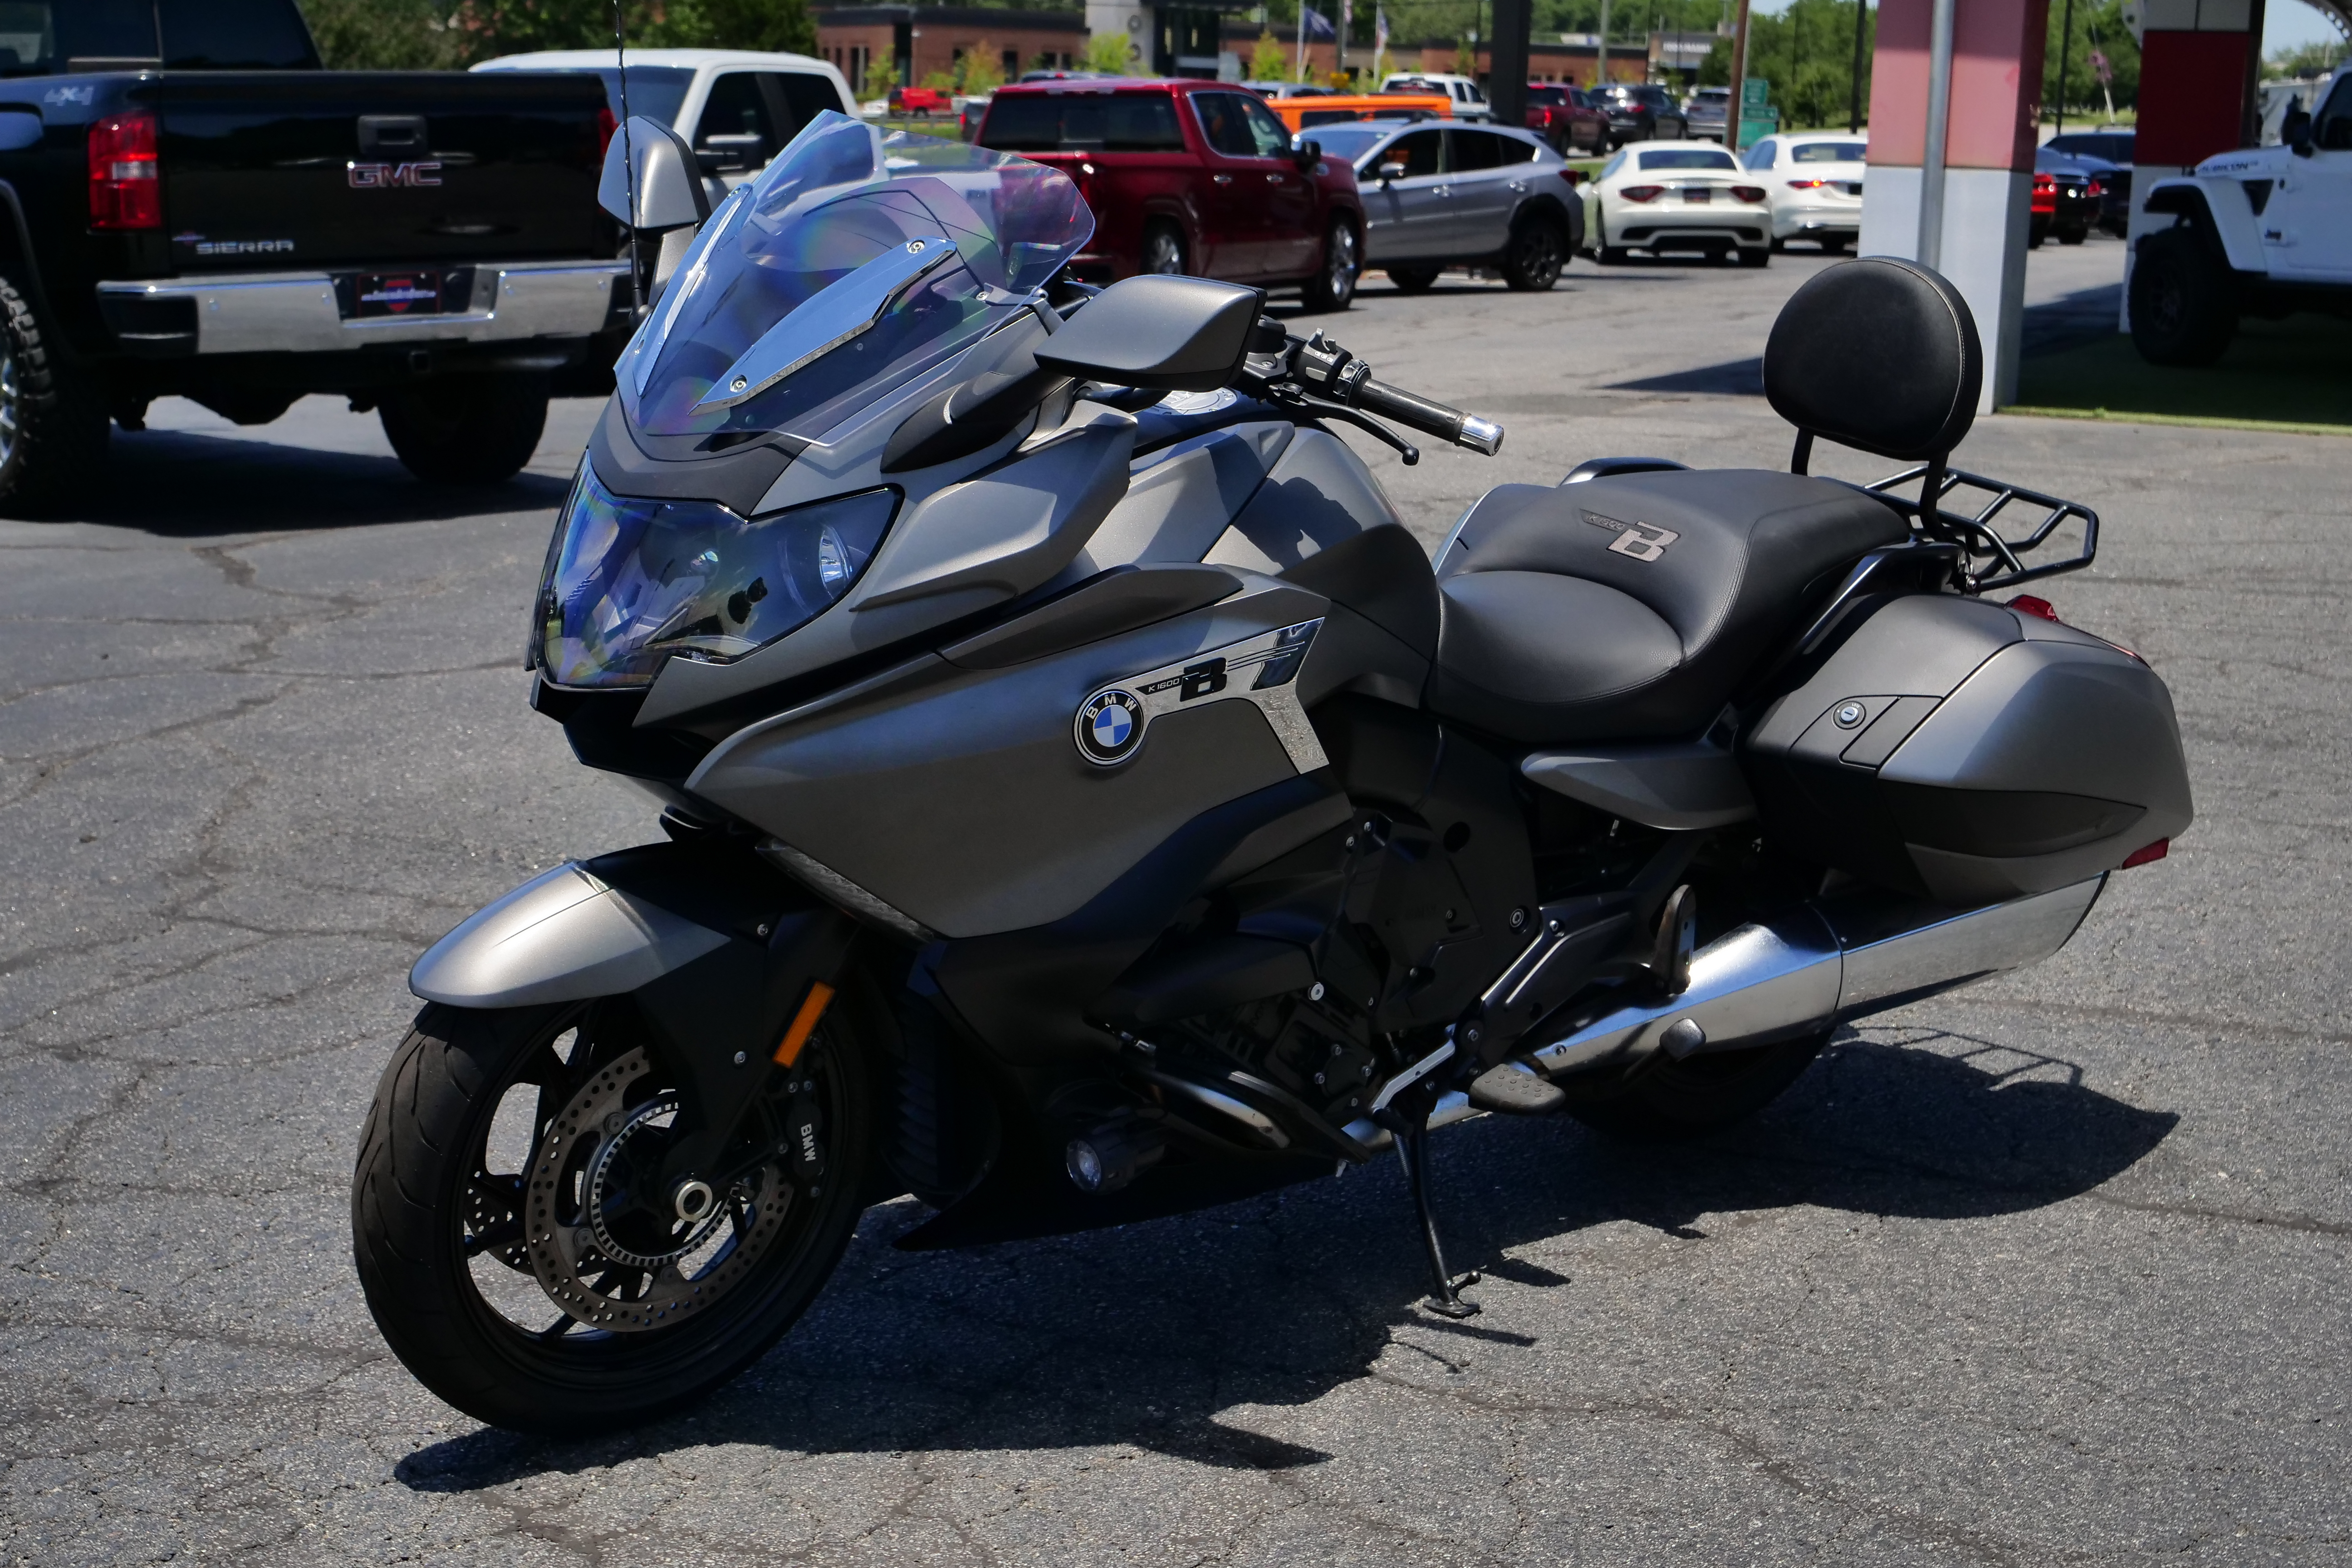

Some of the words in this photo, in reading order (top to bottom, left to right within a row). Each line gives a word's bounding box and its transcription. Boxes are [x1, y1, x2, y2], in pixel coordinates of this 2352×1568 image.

[348, 161, 441, 187] GMC
[196, 239, 293, 255] SIERRA
[1157, 678, 1180, 690] 1600
[1085, 693, 1137, 719] BMW
[801, 1123, 816, 1161] BMW
